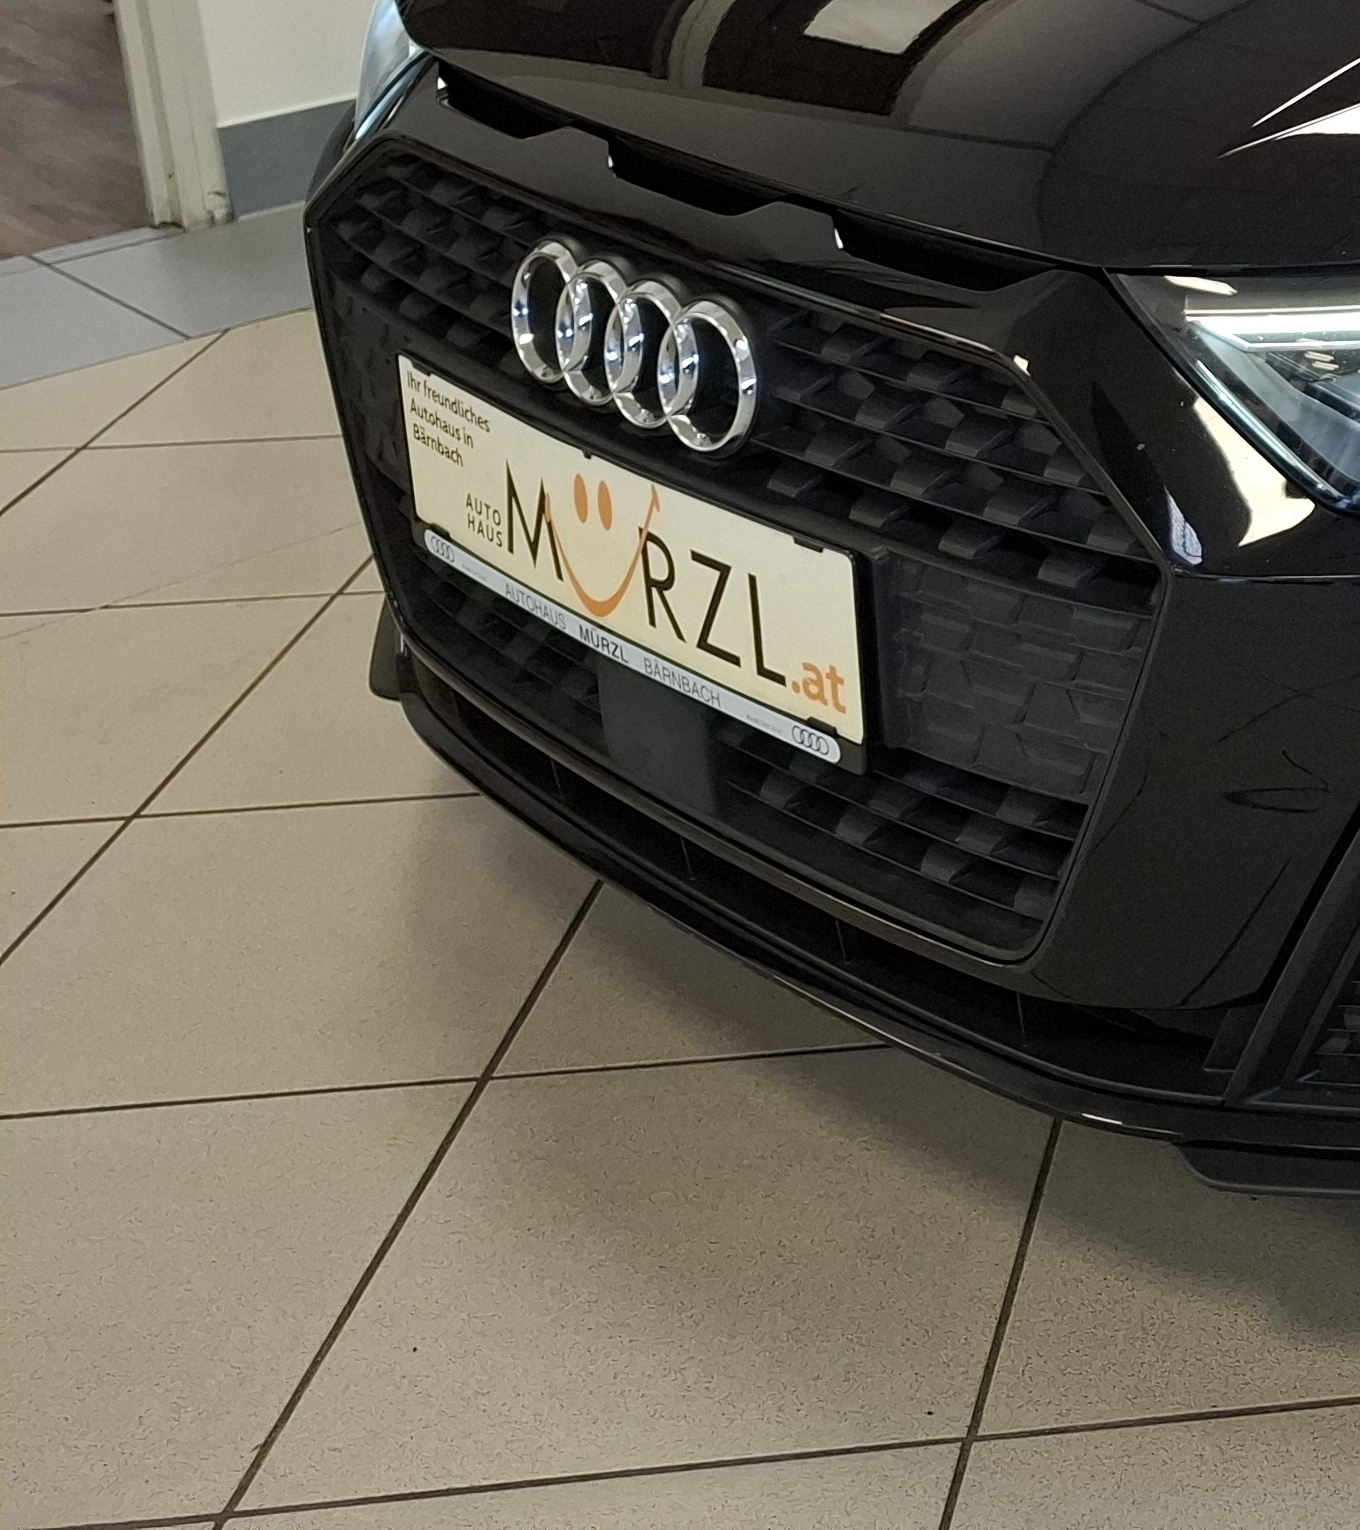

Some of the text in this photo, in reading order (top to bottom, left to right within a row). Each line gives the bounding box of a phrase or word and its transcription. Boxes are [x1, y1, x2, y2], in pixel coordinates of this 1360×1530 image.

[407, 371, 490, 433] Ihr freundliches
[410, 397, 474, 449] Autohaus in
[413, 423, 464, 468] Bärnbach
[466, 493, 501, 526] AUTO
[467, 513, 503, 548] HAUS
[505, 583, 721, 707] AUTOHAUS MÜRZL BÄRNBACH
